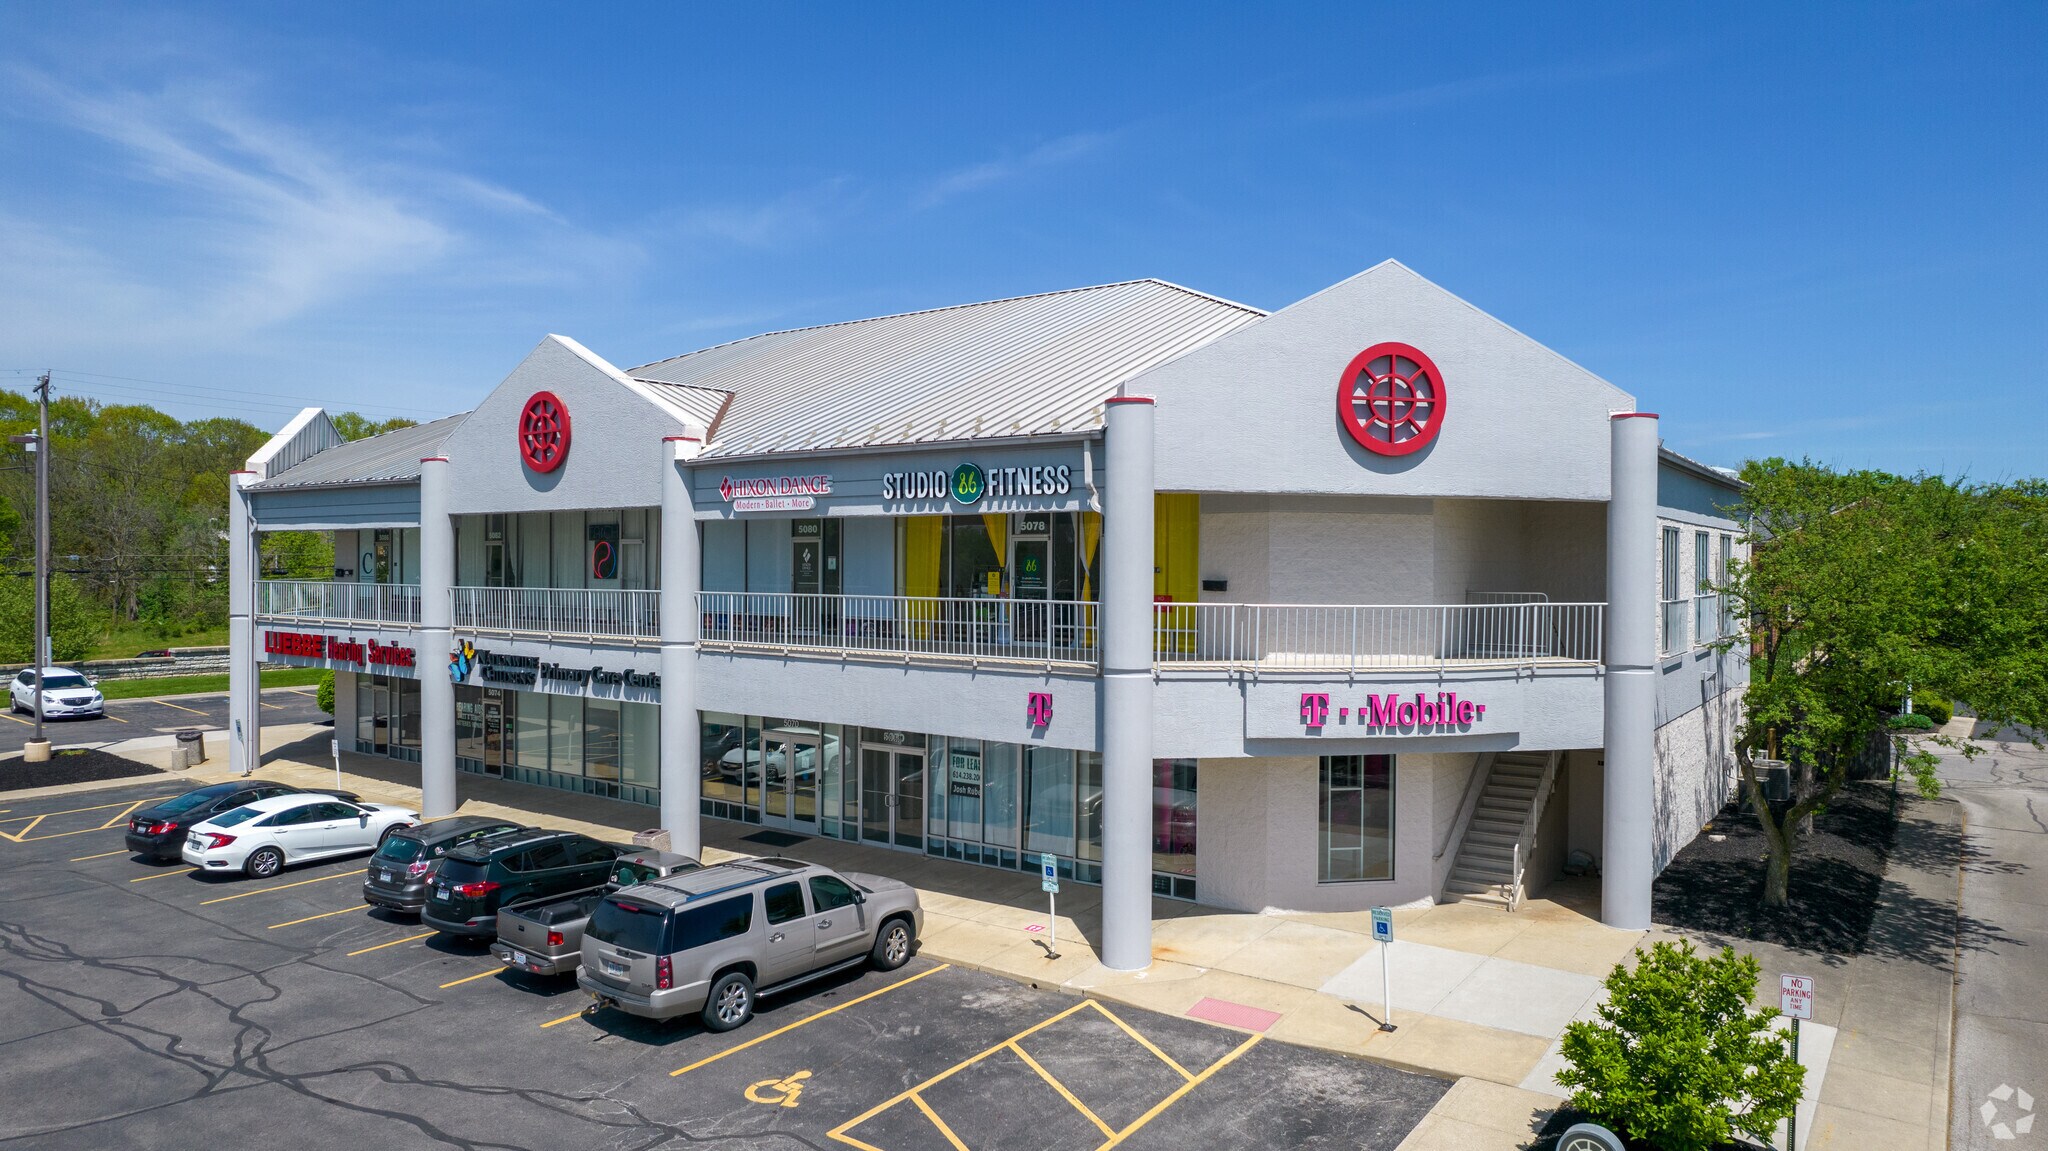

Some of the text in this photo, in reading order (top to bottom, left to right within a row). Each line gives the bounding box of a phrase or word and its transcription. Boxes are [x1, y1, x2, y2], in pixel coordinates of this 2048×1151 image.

[733, 476, 829, 497] HIXON DANCE
[883, 465, 1070, 499] STUDIO 86 FITNESS
[736, 499, 810, 509] Modern Ballet More
[798, 525, 818, 533] 5080
[1020, 521, 1045, 531] 5078
[265, 631, 414, 667] LUEBBE Hearing Services
[540, 662, 661, 689] Primary Care Cente
[1027, 692, 1053, 727] T
[783, 718, 800, 728] 5070
[952, 756, 965, 769] FOR
[953, 785, 966, 794] Josh
[1791, 979, 1803, 989] NO
[1782, 987, 1811, 1000] PARKING
[1790, 997, 1803, 1005] ANY
[1790, 1003, 1803, 1011] TIME
